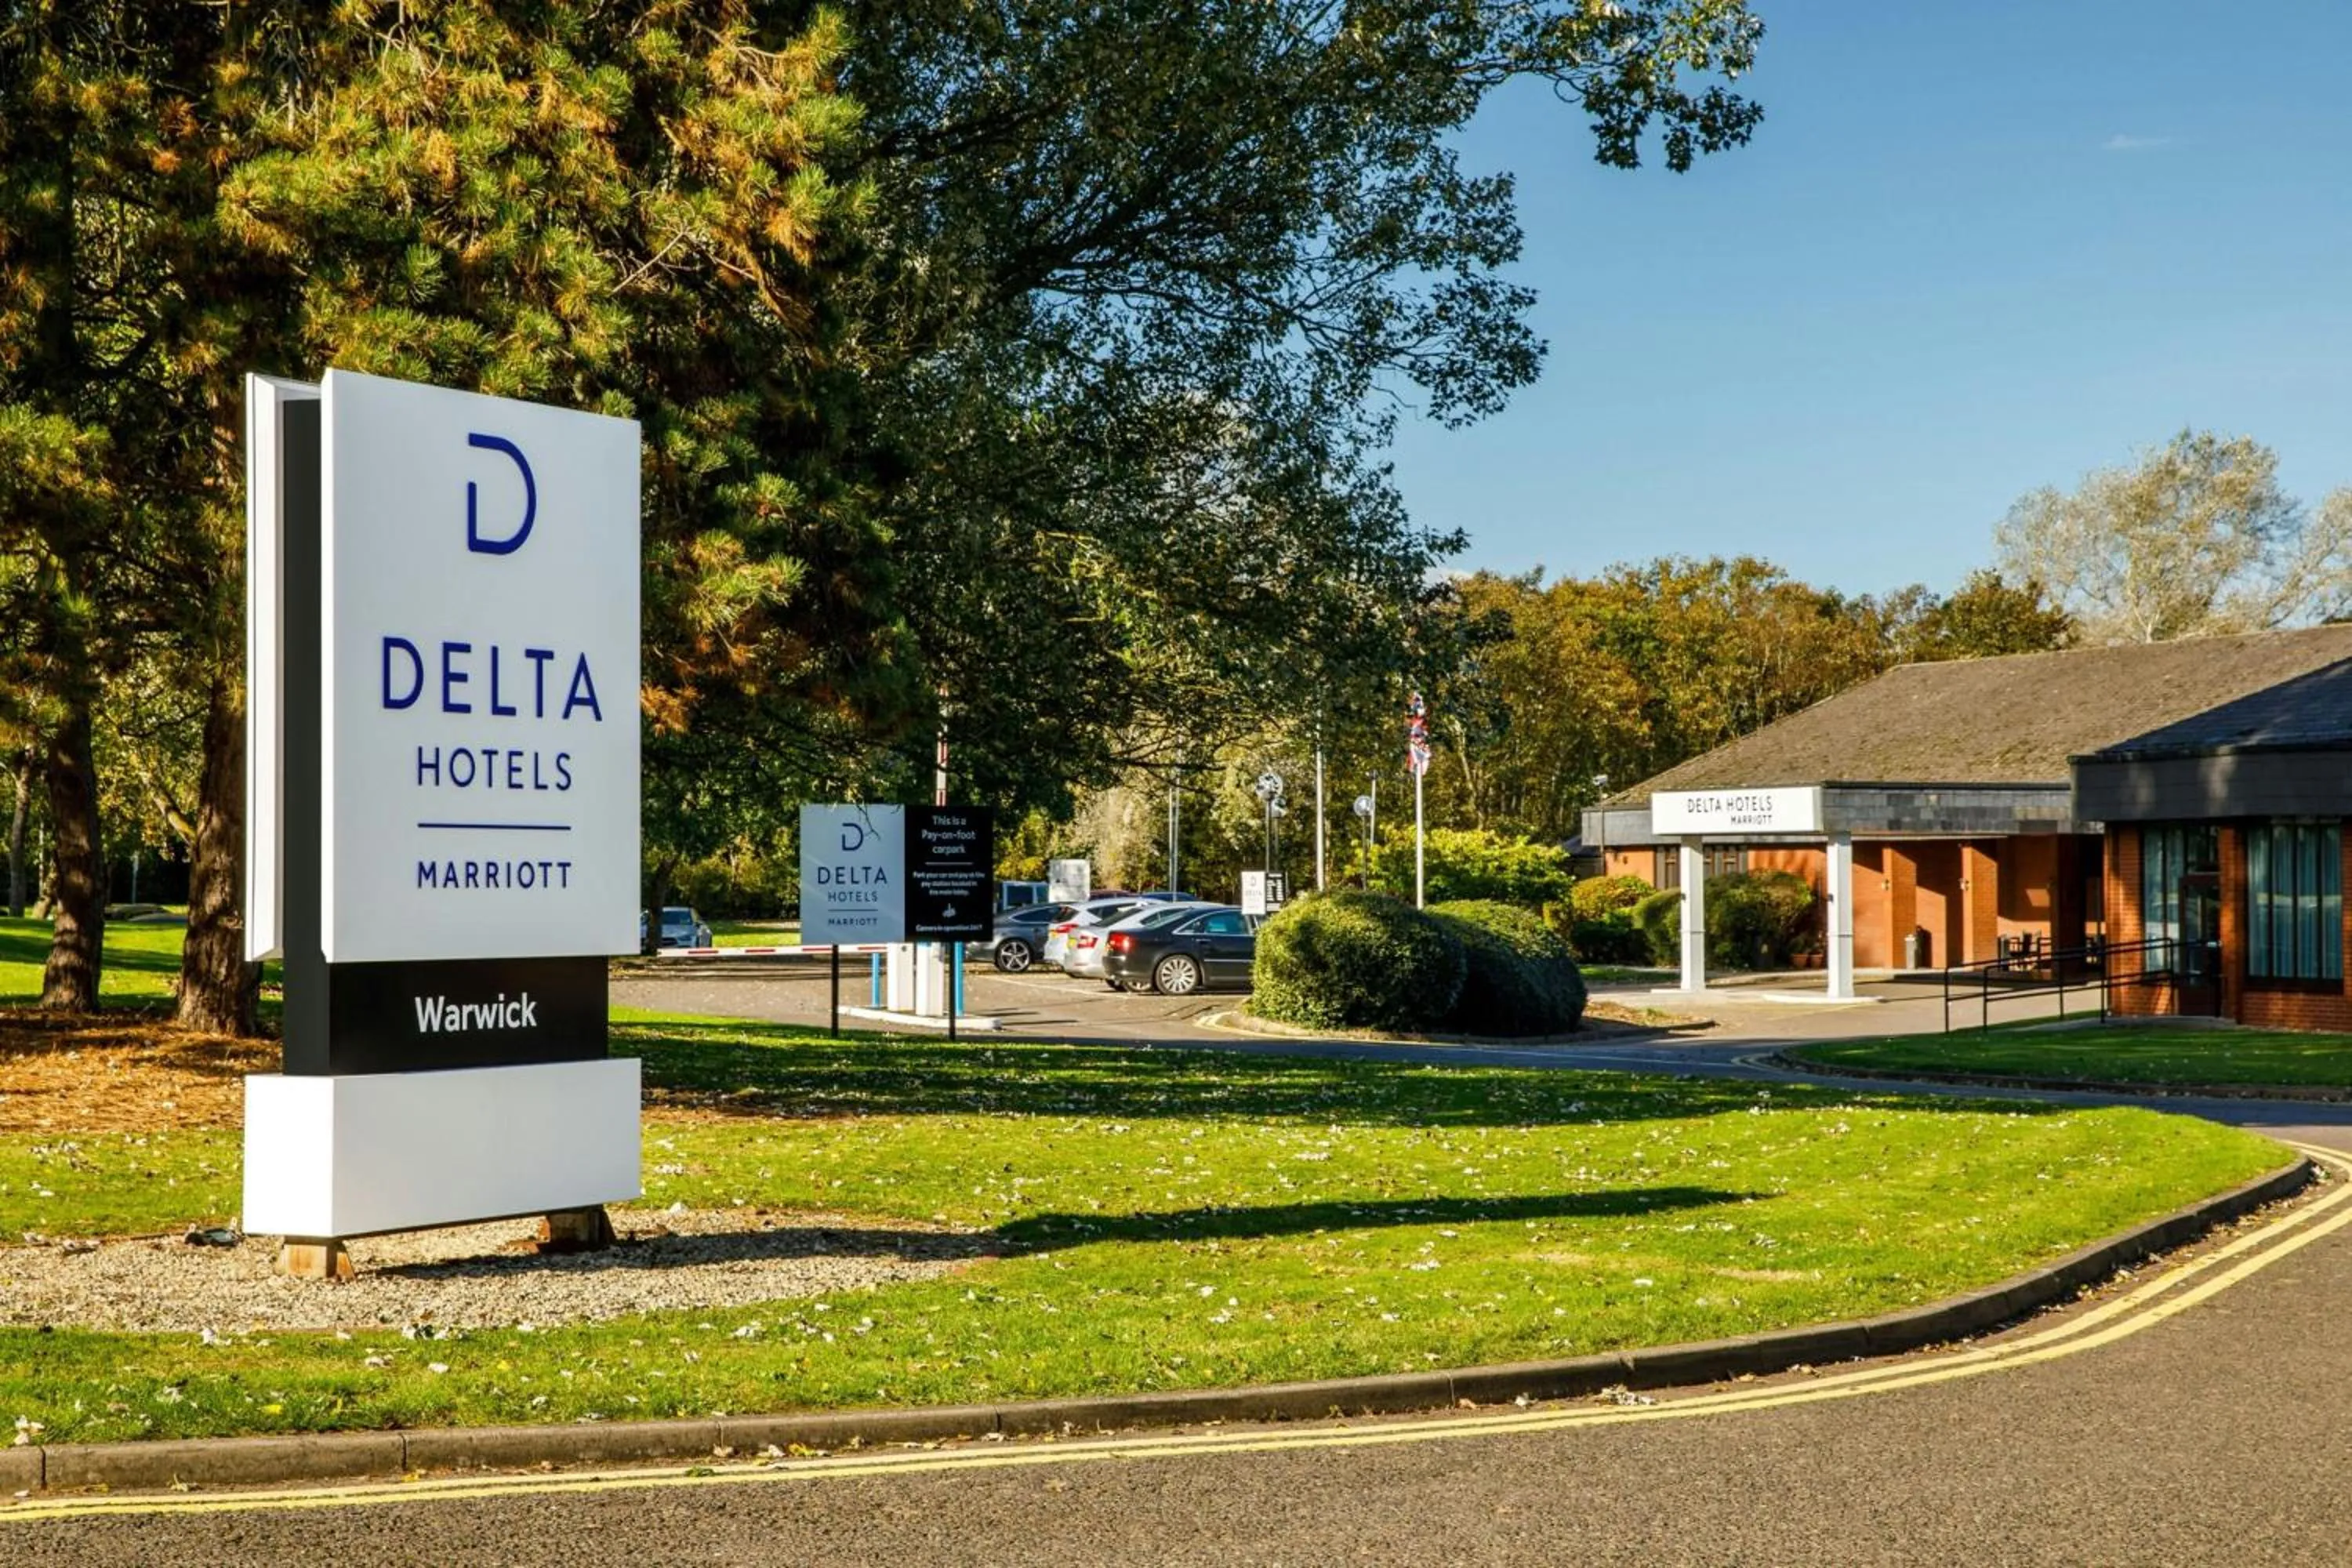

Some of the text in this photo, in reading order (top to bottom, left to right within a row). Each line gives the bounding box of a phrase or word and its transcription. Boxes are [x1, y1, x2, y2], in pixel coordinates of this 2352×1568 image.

[466, 432, 537, 556] D
[382, 636, 603, 722] DELTA
[417, 746, 572, 791] HOTELS
[1687, 796, 1773, 813] DELTA HOTELS
[932, 815, 951, 826] This
[1730, 815, 1773, 826] MARRIOTT
[841, 822, 863, 851] D
[921, 829, 976, 842] Pay-on-foot
[417, 861, 572, 889] MARRIOTT
[817, 866, 887, 885] DELTA
[828, 891, 878, 902] HOTELS
[828, 917, 877, 926] MARRIOTT
[415, 992, 537, 1033] Warwick
